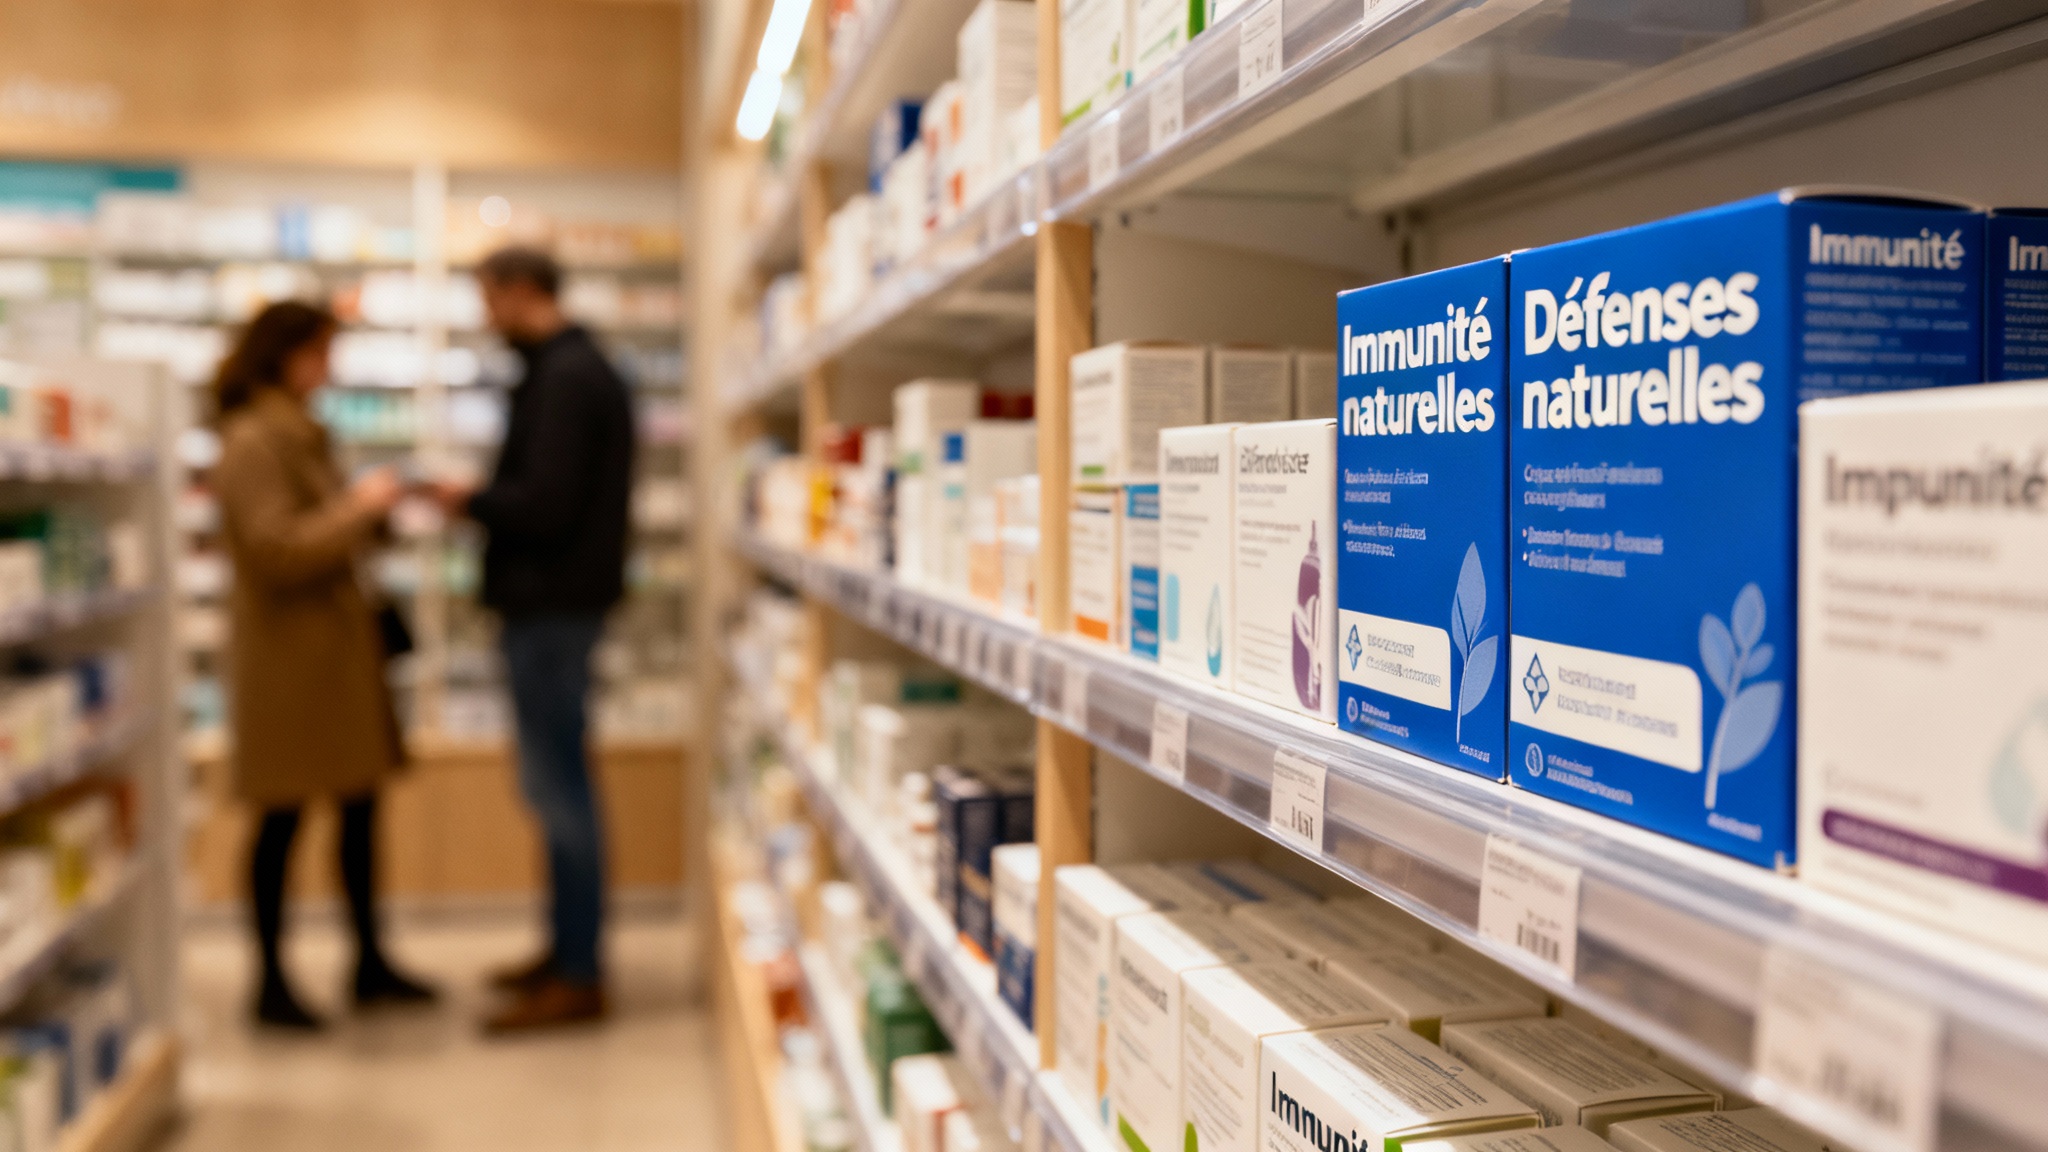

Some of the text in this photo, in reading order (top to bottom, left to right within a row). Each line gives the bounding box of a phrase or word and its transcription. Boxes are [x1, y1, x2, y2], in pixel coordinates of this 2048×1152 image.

[1808, 223, 1965, 270] Immunité
[1343, 296, 1493, 376] Immunité
[1524, 271, 1760, 356] Défenses
[1343, 371, 1496, 437] naturelles
[1522, 345, 1766, 430] naturelles
